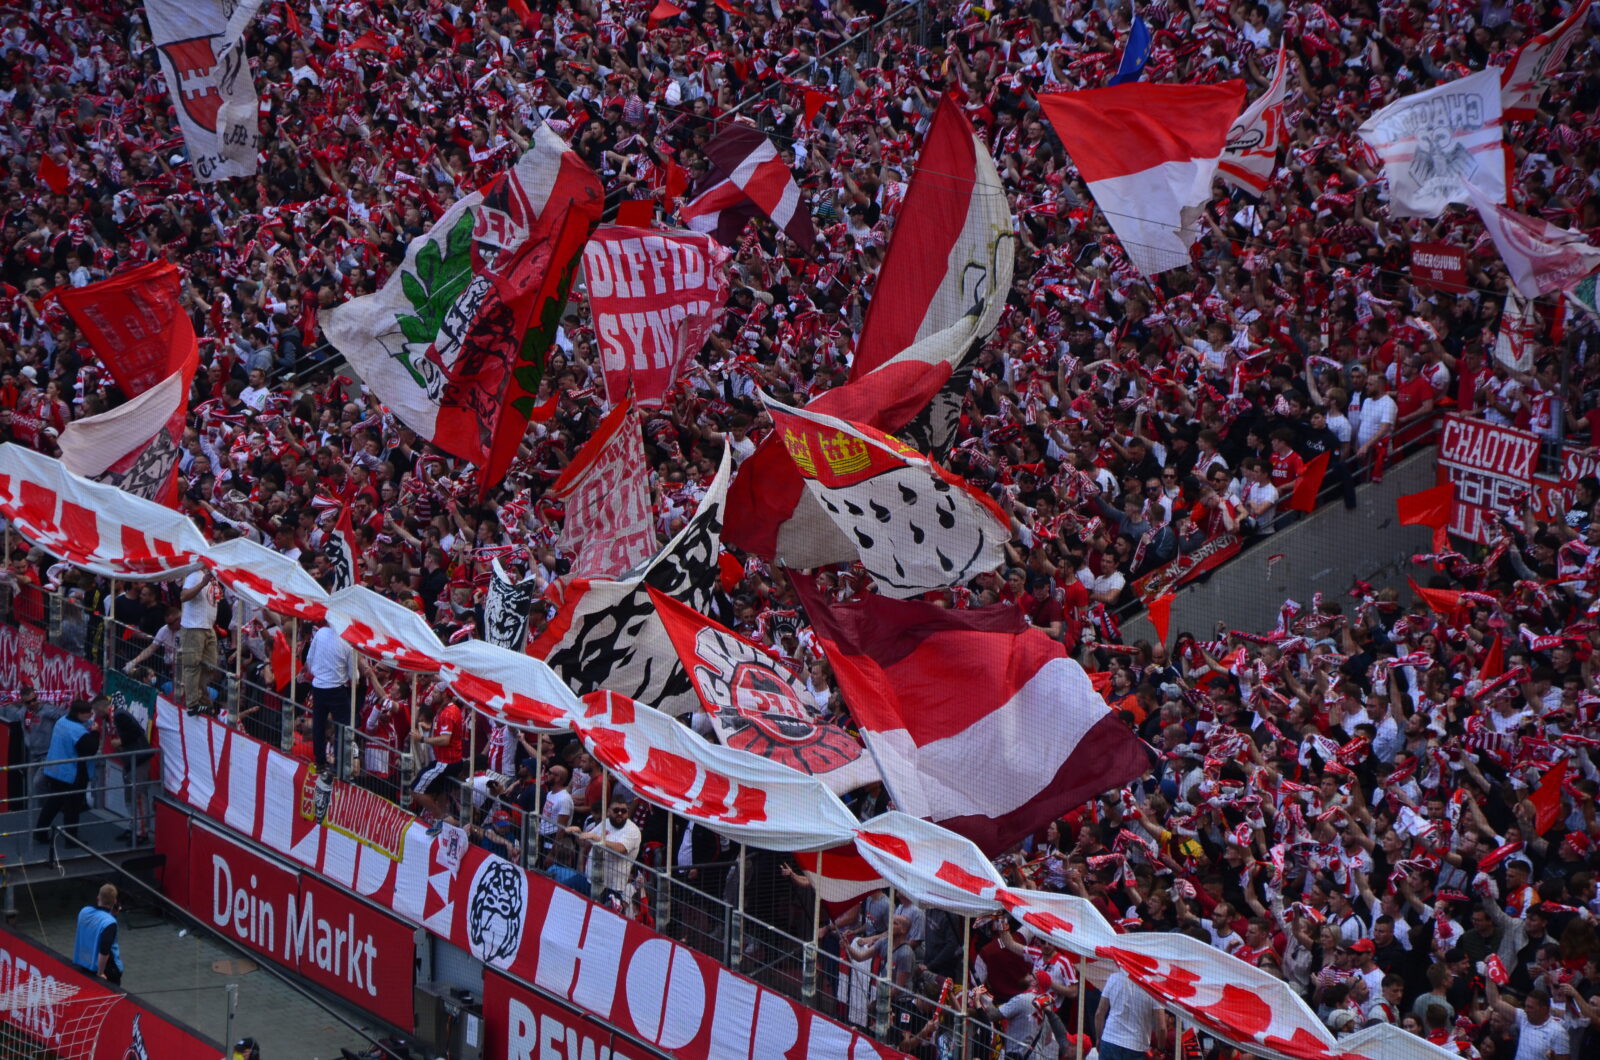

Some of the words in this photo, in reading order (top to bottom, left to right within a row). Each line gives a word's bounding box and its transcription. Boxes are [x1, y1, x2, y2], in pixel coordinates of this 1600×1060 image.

[1441, 419, 1538, 480] CHAOTIX
[212, 853, 275, 953] Dein
[284, 890, 378, 997] Markt
